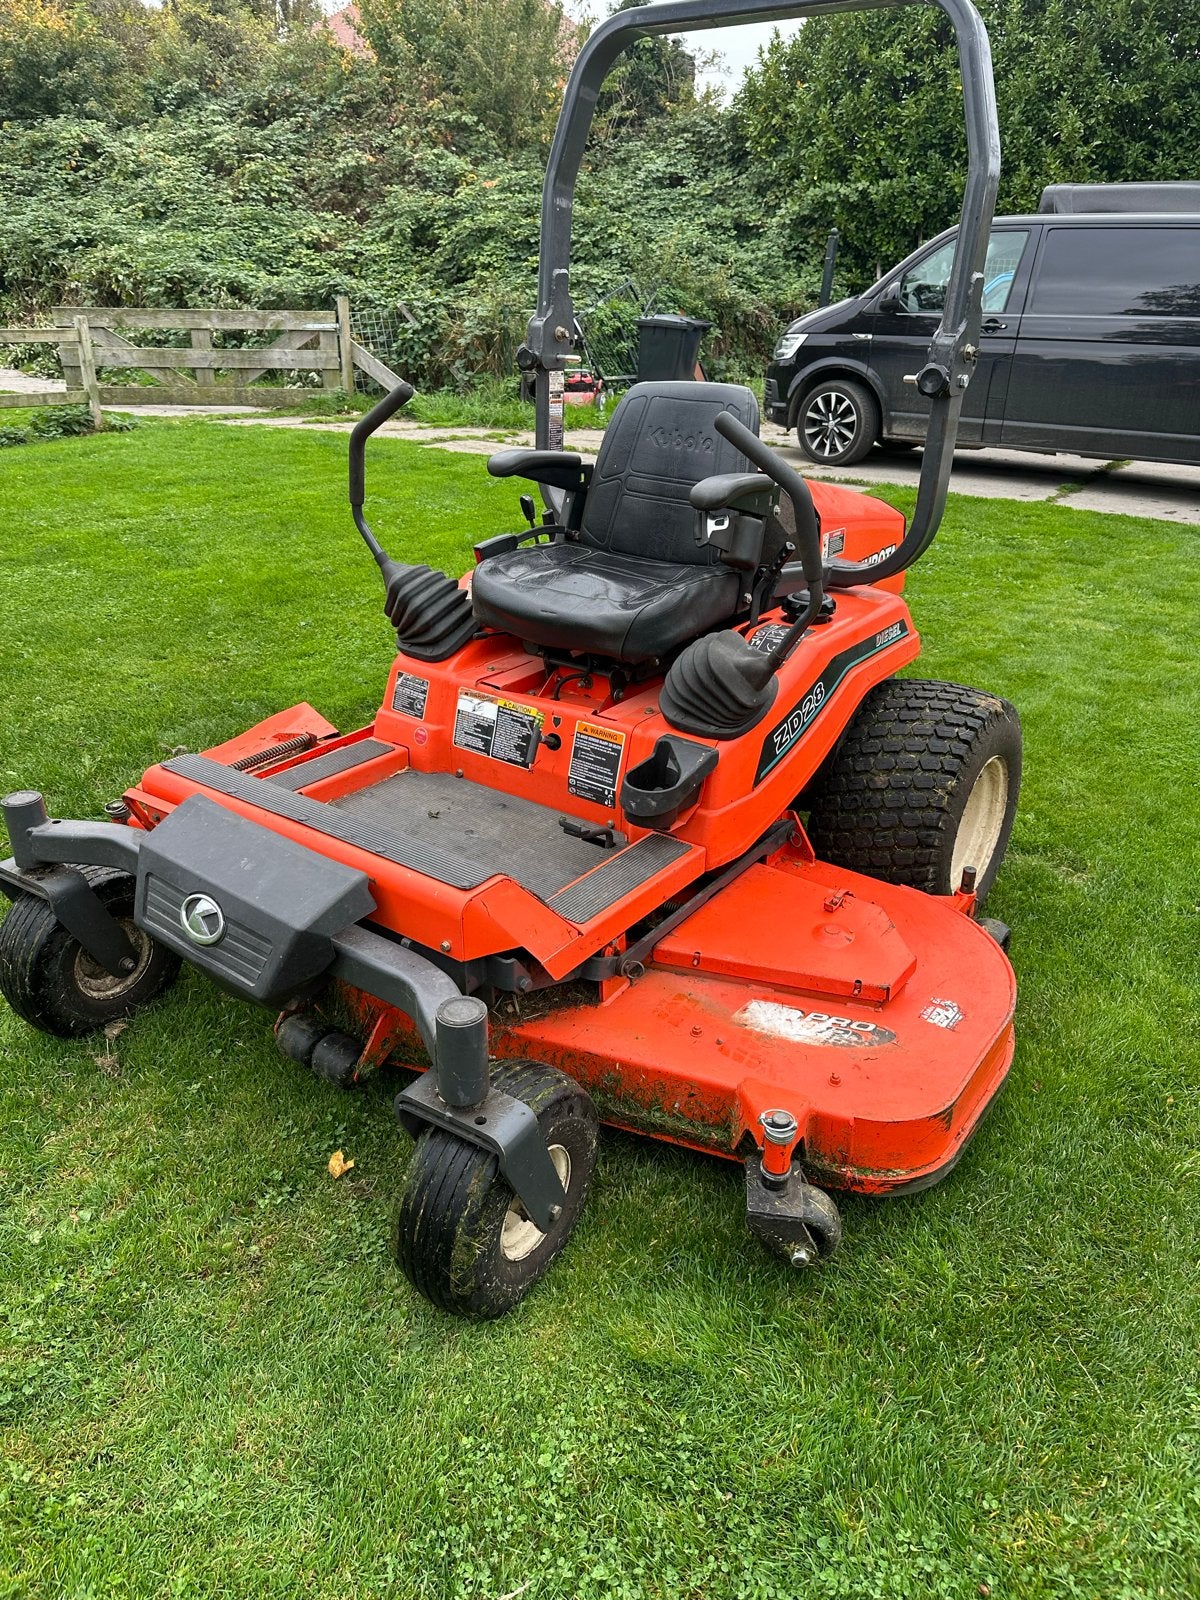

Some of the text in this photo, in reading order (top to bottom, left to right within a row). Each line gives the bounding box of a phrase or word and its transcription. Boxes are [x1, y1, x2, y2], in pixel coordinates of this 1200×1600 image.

[647, 425, 714, 453] Kubota
[876, 623, 902, 647] DIESEL
[508, 702, 532, 714] CAUTION
[774, 682, 825, 755] ZD28
[590, 727, 618, 741] WARNING
[804, 1012, 876, 1032] PRO
